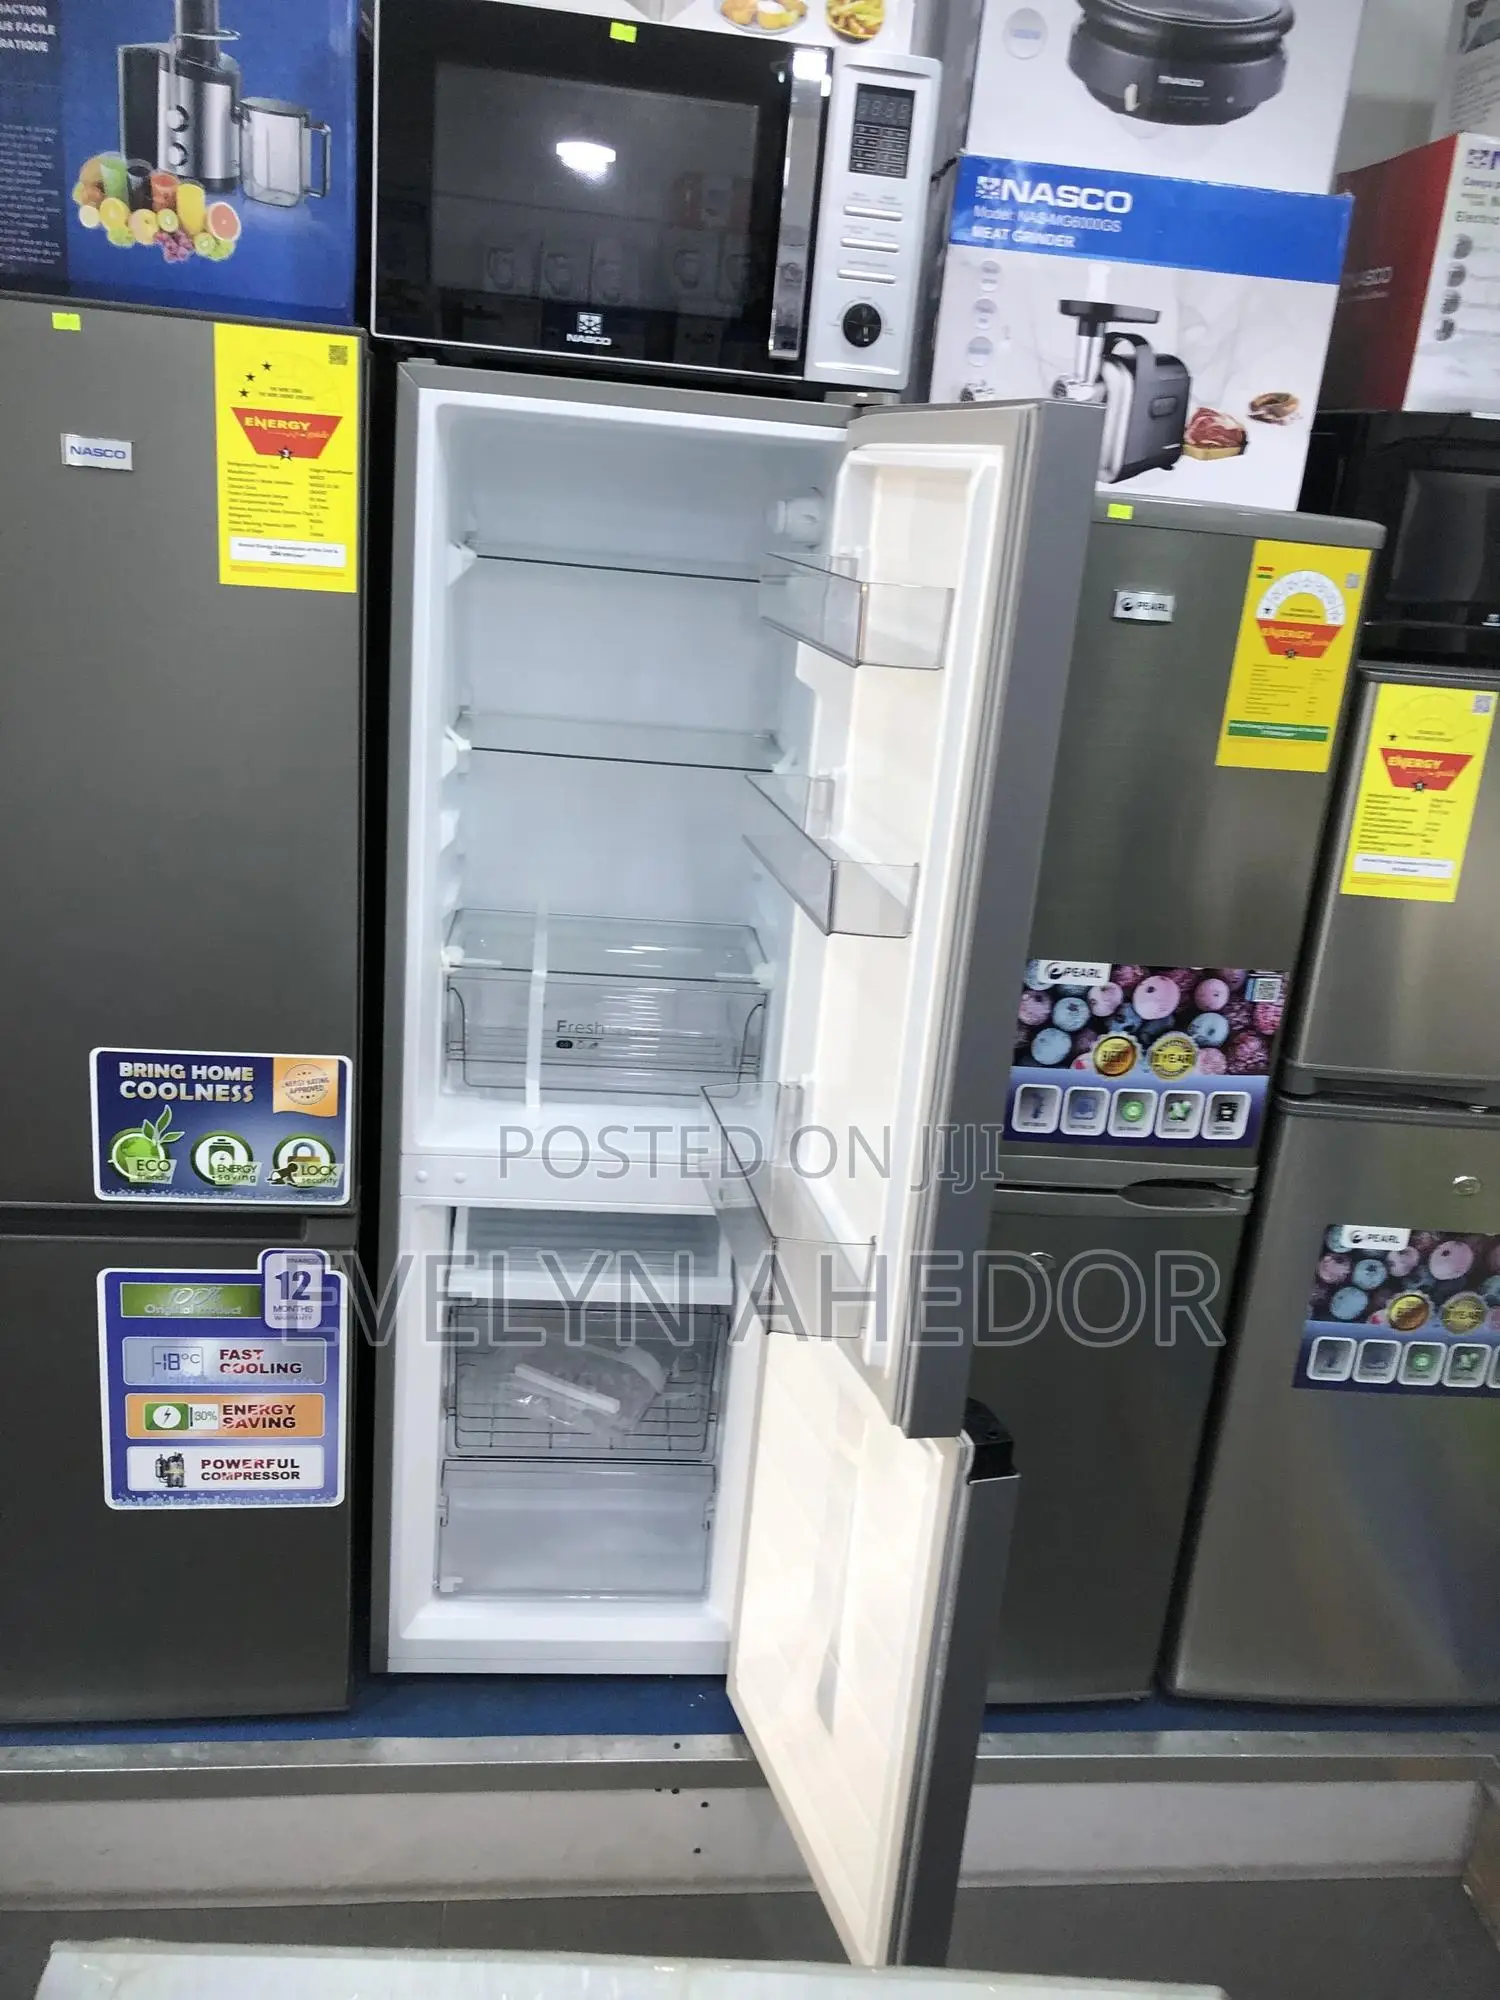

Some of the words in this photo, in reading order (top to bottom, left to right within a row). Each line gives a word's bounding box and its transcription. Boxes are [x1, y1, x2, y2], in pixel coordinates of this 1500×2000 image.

[16, 22, 56, 36] FACILE
[1001, 178, 1133, 213] NASCO
[244, 416, 311, 431] ENERGY
[70, 446, 126, 460] NASCO
[1136, 601, 1169, 612] PEARL
[1064, 967, 1102, 979] PEARL
[556, 1020, 604, 1036] Fresh
[119, 1061, 186, 1079] BRING
[191, 1064, 254, 1082] HOME
[119, 1081, 254, 1102] COOLNESS
[136, 1160, 171, 1172] ECO
[217, 1164, 257, 1174] ENERGY
[301, 1165, 337, 1176] LOCK
[217, 1174, 257, 1184] saving
[301, 1176, 338, 1186] security
[275, 1271, 311, 1300] 12
[273, 1305, 314, 1313] MONTHS
[219, 1349, 264, 1360] FAST
[219, 1363, 302, 1374] COOLING
[194, 1410, 218, 1421] 30%
[222, 1404, 296, 1416] ENERGY
[222, 1417, 296, 1429] SAVING
[201, 1459, 300, 1469] POWERFUL
[201, 1471, 300, 1481] COMPRESSOR
